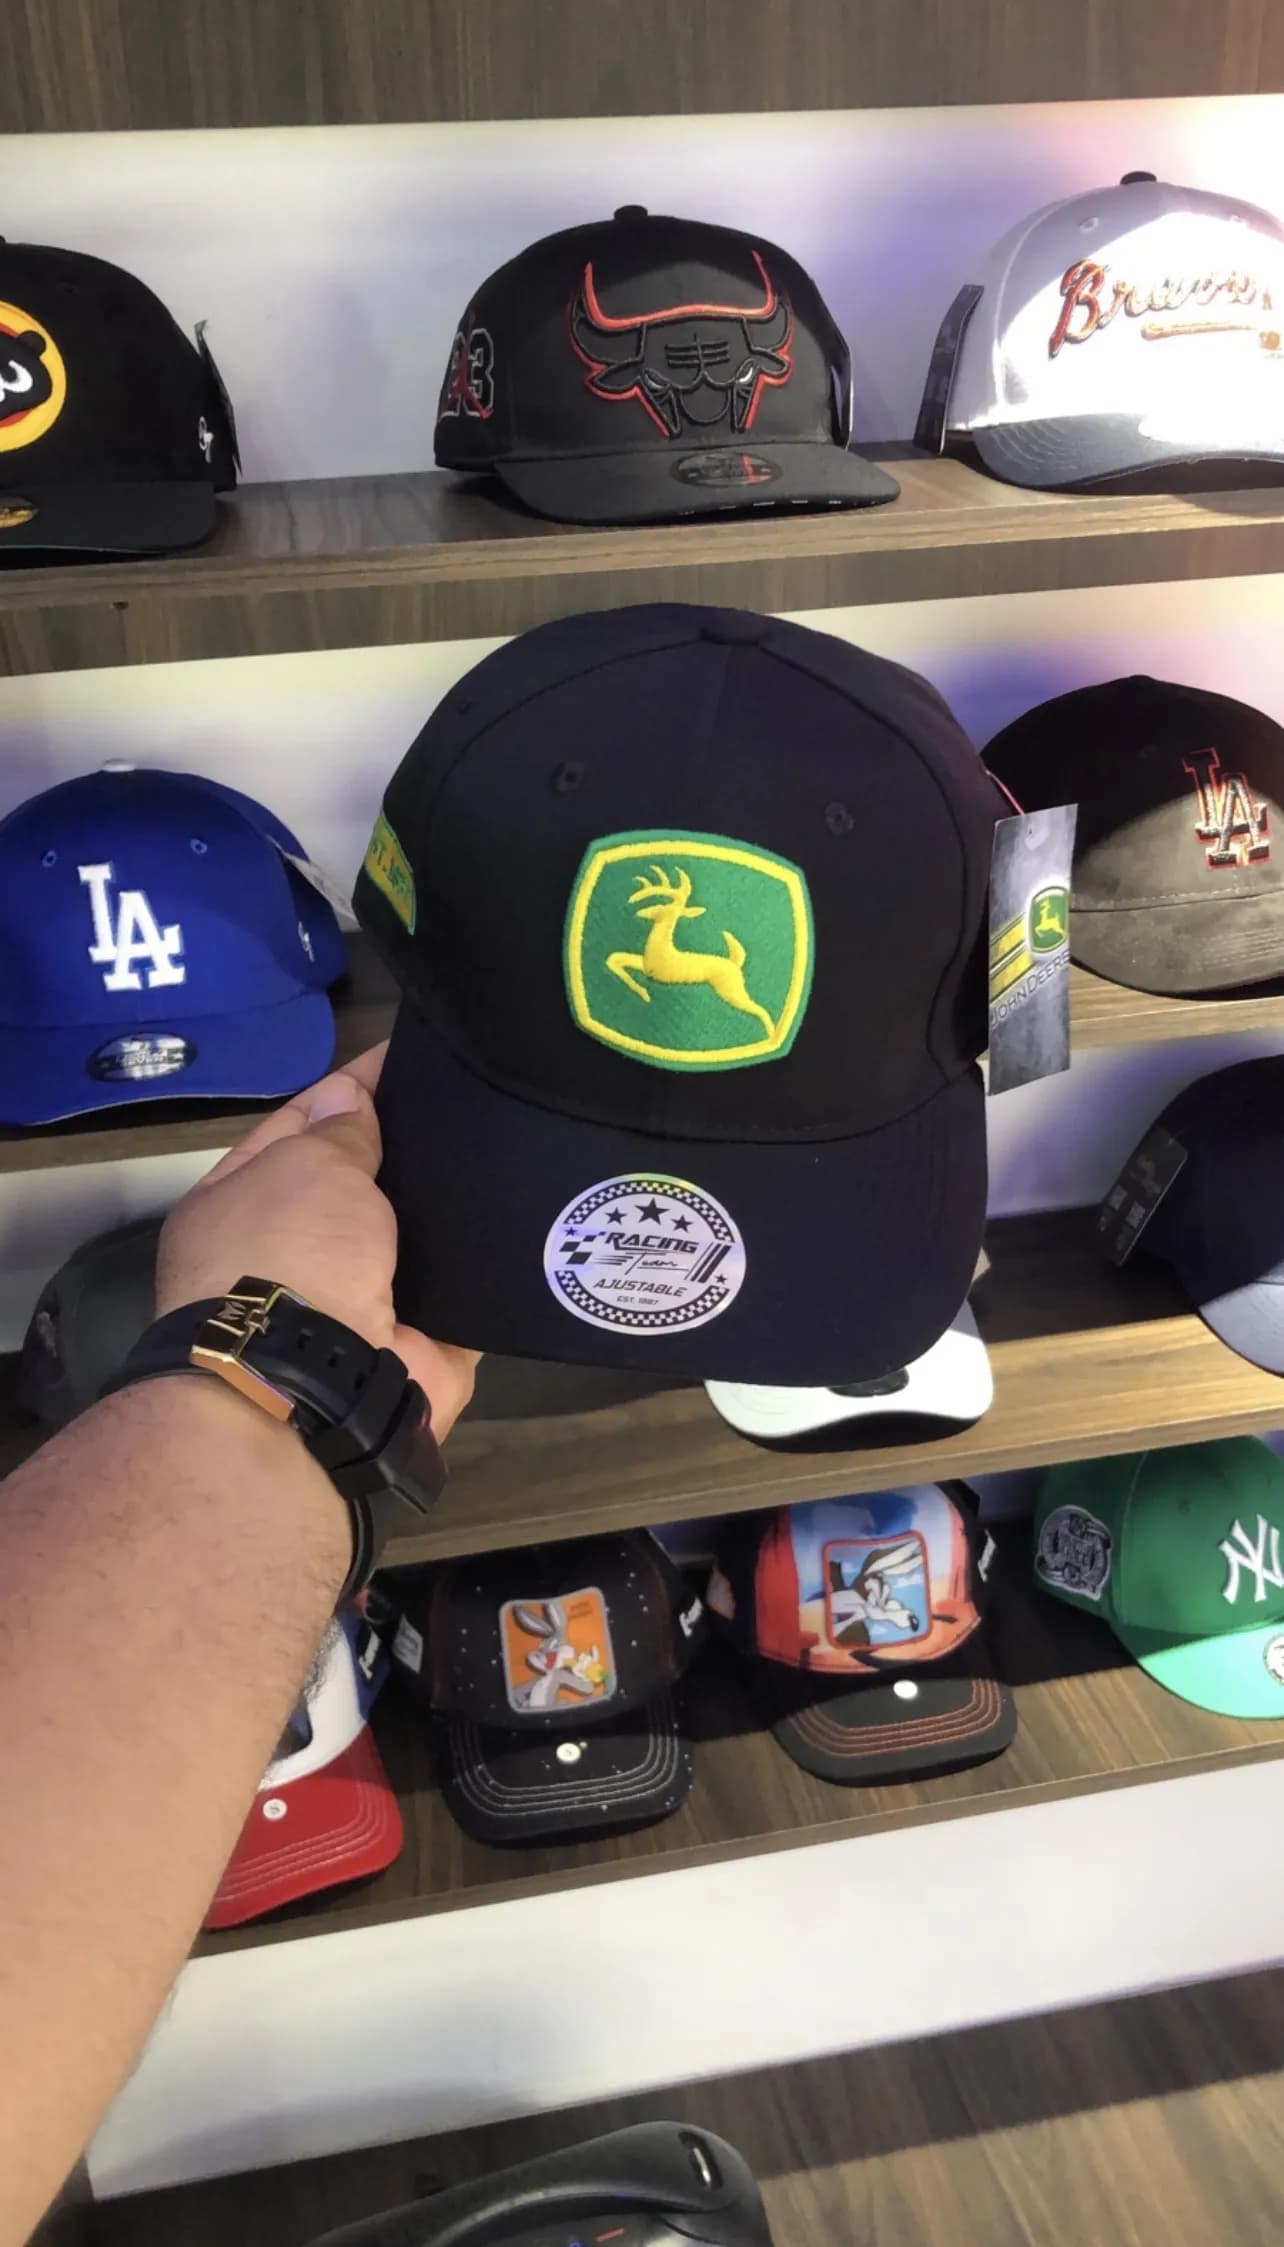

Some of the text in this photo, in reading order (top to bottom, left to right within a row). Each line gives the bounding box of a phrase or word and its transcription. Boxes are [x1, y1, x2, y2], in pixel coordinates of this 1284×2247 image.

[1182, 747, 1270, 869] LA
[77, 862, 186, 991] LA
[991, 949, 1070, 1030] JOHN DEERE
[604, 1232, 699, 1254] RACING
[593, 1279, 688, 1297] AJUSTABLE
[1219, 1514, 1284, 1604] NY
